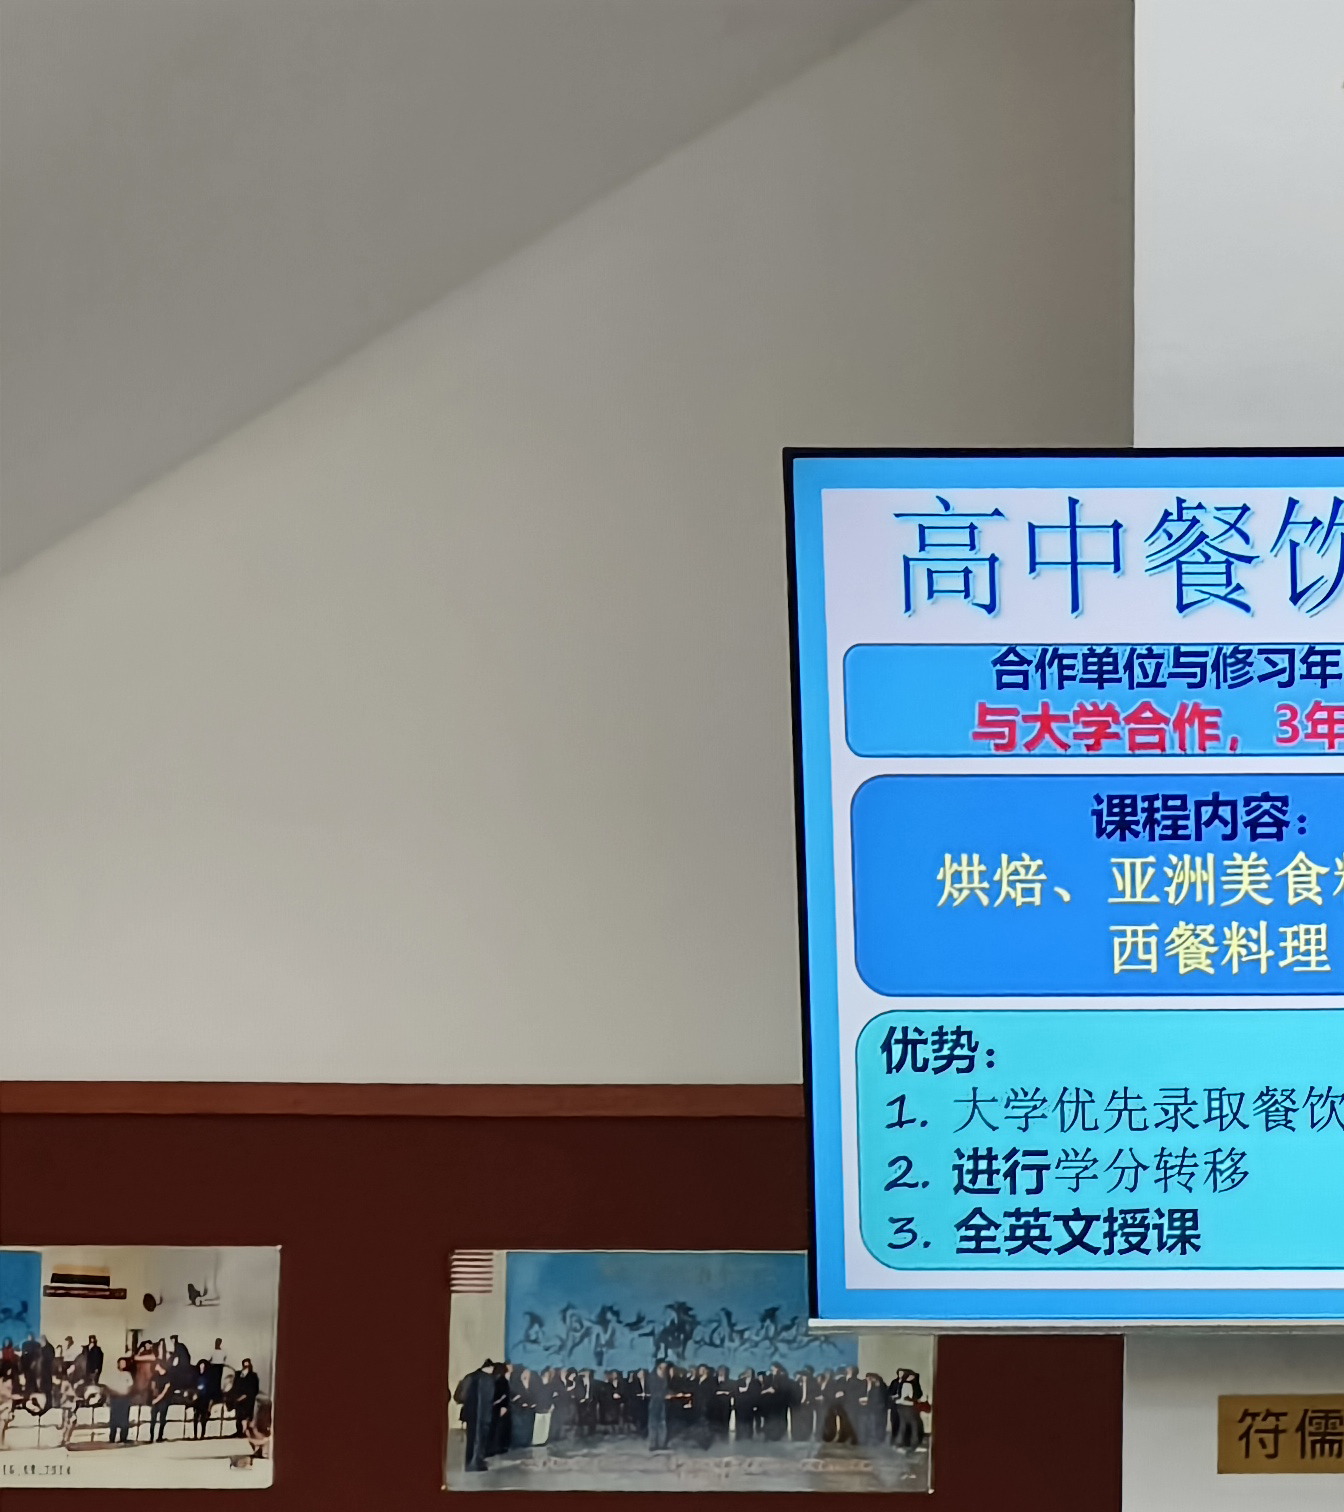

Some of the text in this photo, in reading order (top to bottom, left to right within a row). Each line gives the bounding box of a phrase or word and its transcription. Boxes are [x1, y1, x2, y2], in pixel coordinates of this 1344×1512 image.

[1108, 921, 1332, 975] 西餐料理
[885, 1095, 929, 1130] 1.
[884, 1147, 1250, 1196] 2. 进行学分转移
[886, 1207, 1201, 1256] 3. 全英文授课
